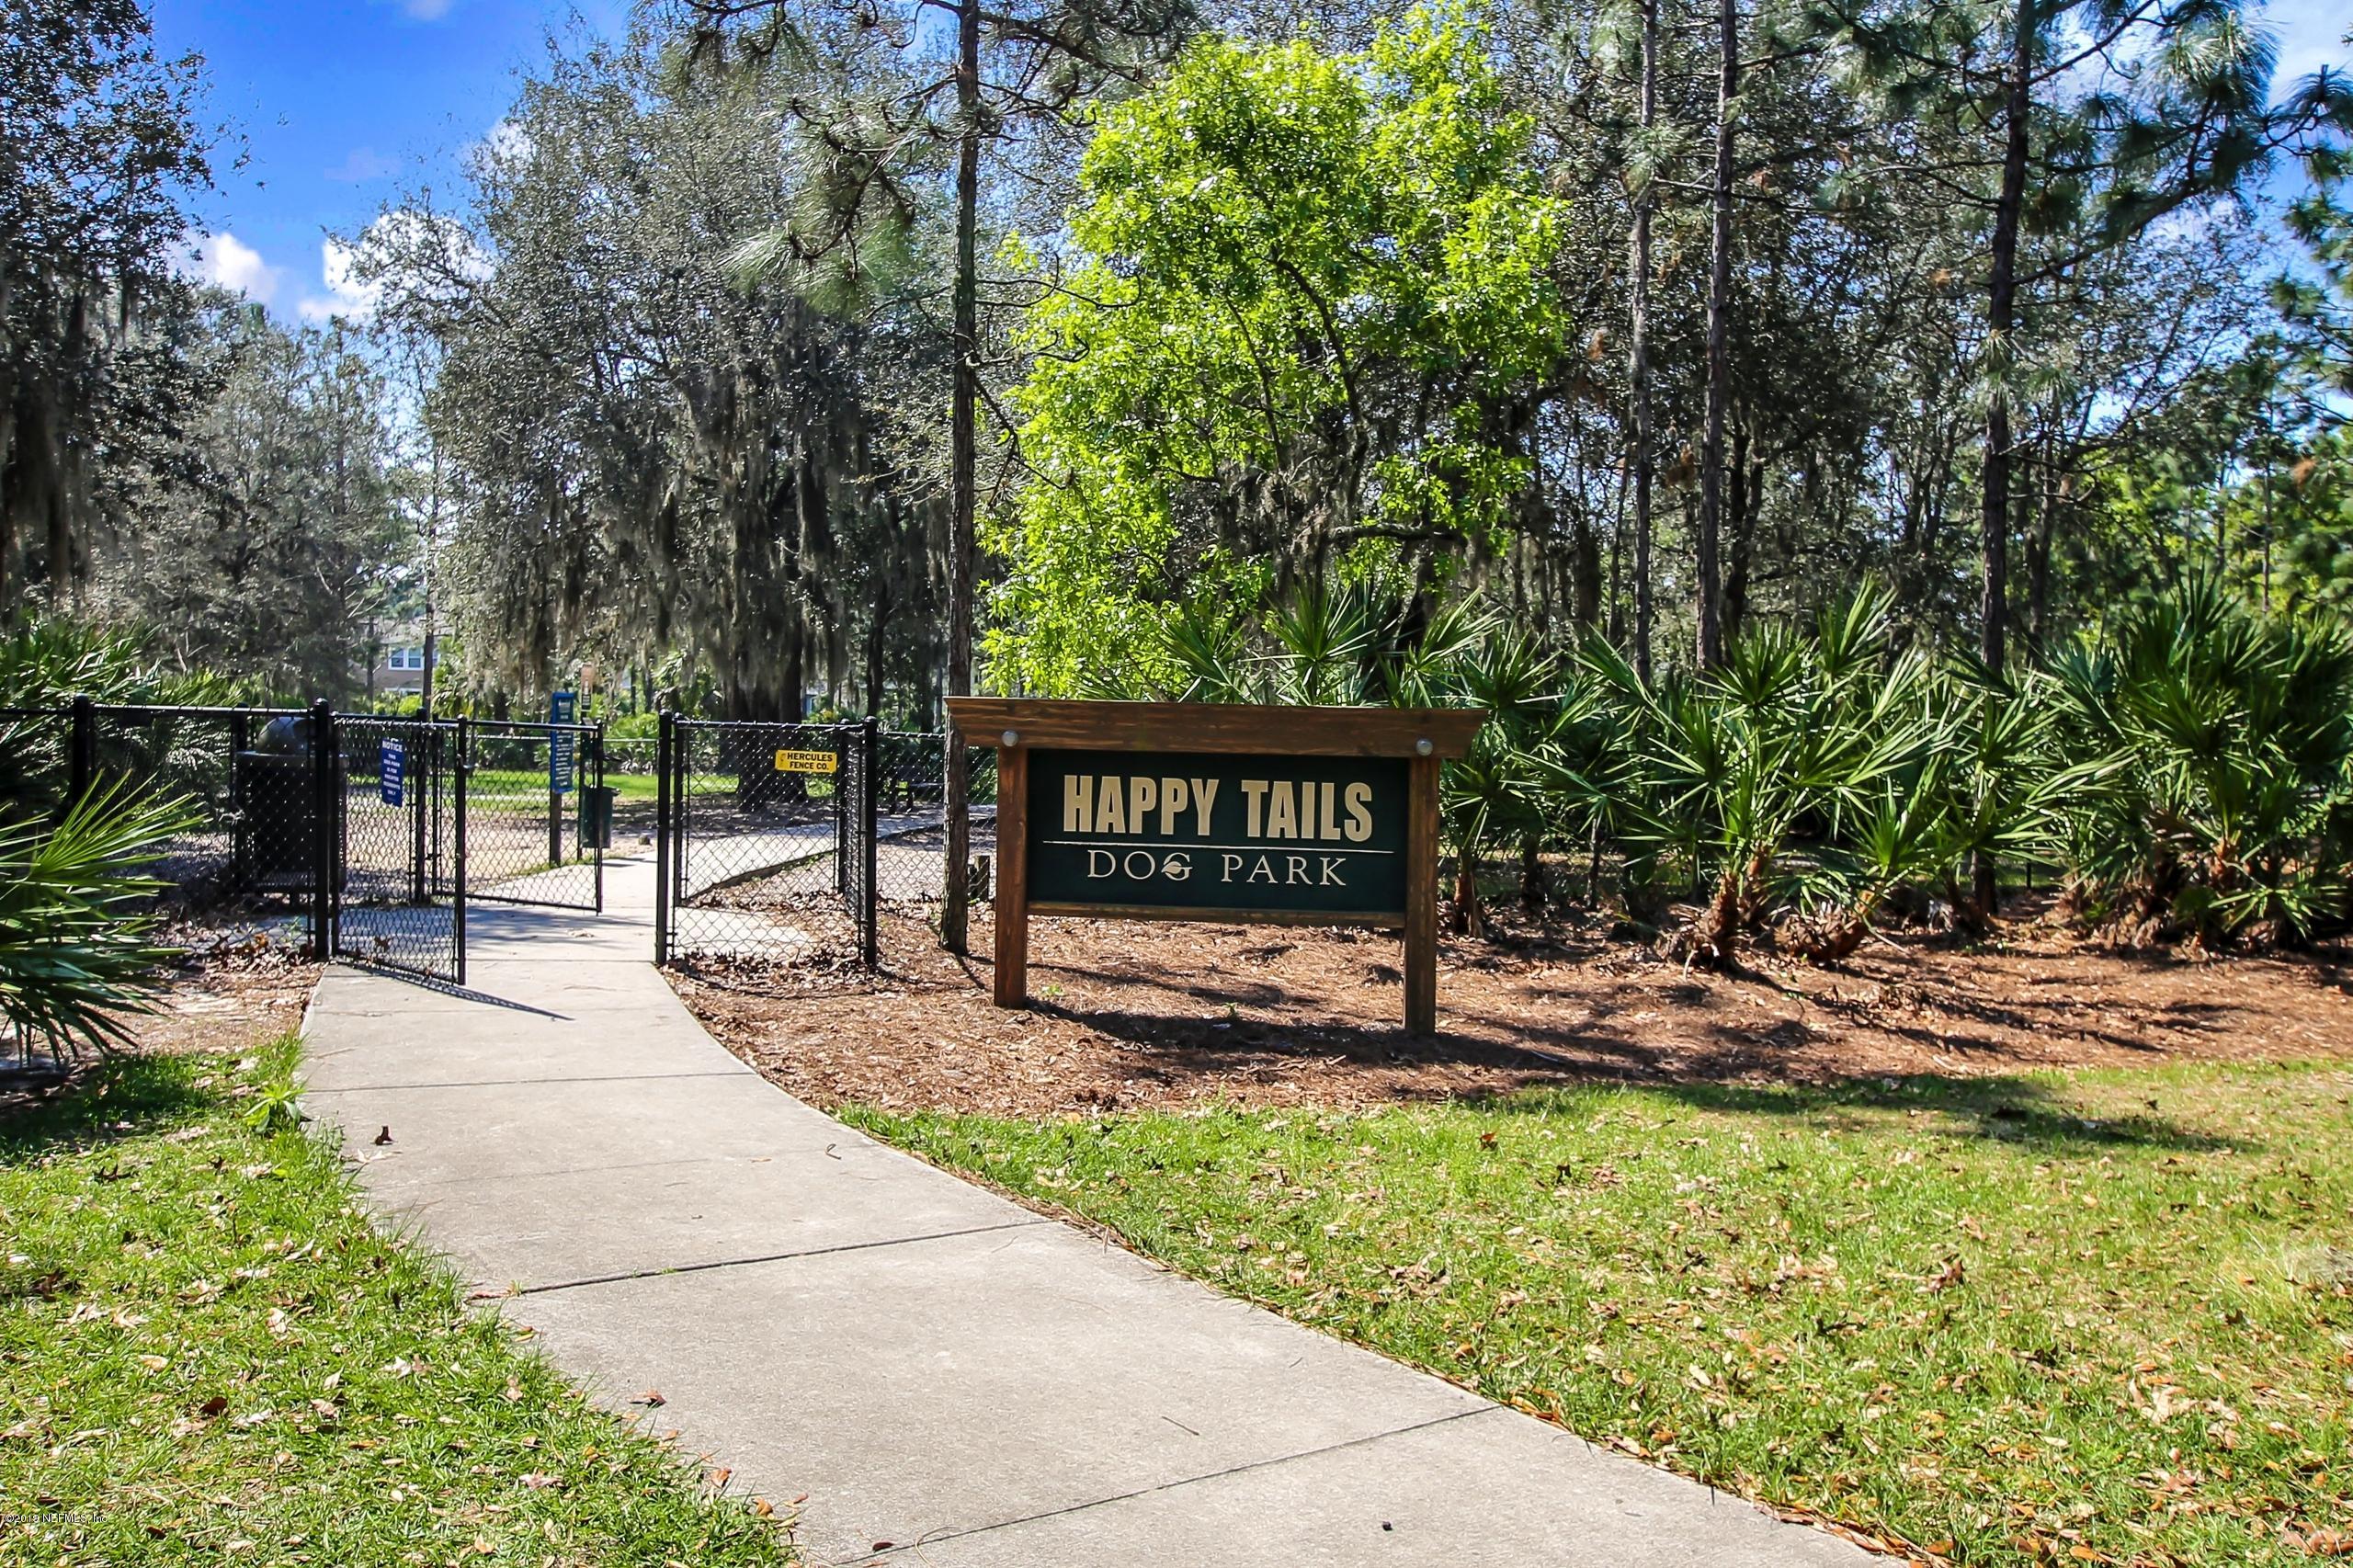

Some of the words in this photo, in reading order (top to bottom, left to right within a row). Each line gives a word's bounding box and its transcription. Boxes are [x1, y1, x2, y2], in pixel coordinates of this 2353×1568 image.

[381, 740, 403, 753] NOTICE
[787, 752, 833, 762] HERCULES
[790, 761, 814, 770] FENCE
[816, 762, 829, 770] CO.
[1063, 774, 1220, 836] HAPPY
[1241, 779, 1372, 842] TAILS
[1087, 849, 1193, 881] DOG
[1221, 854, 1347, 886] PARK
